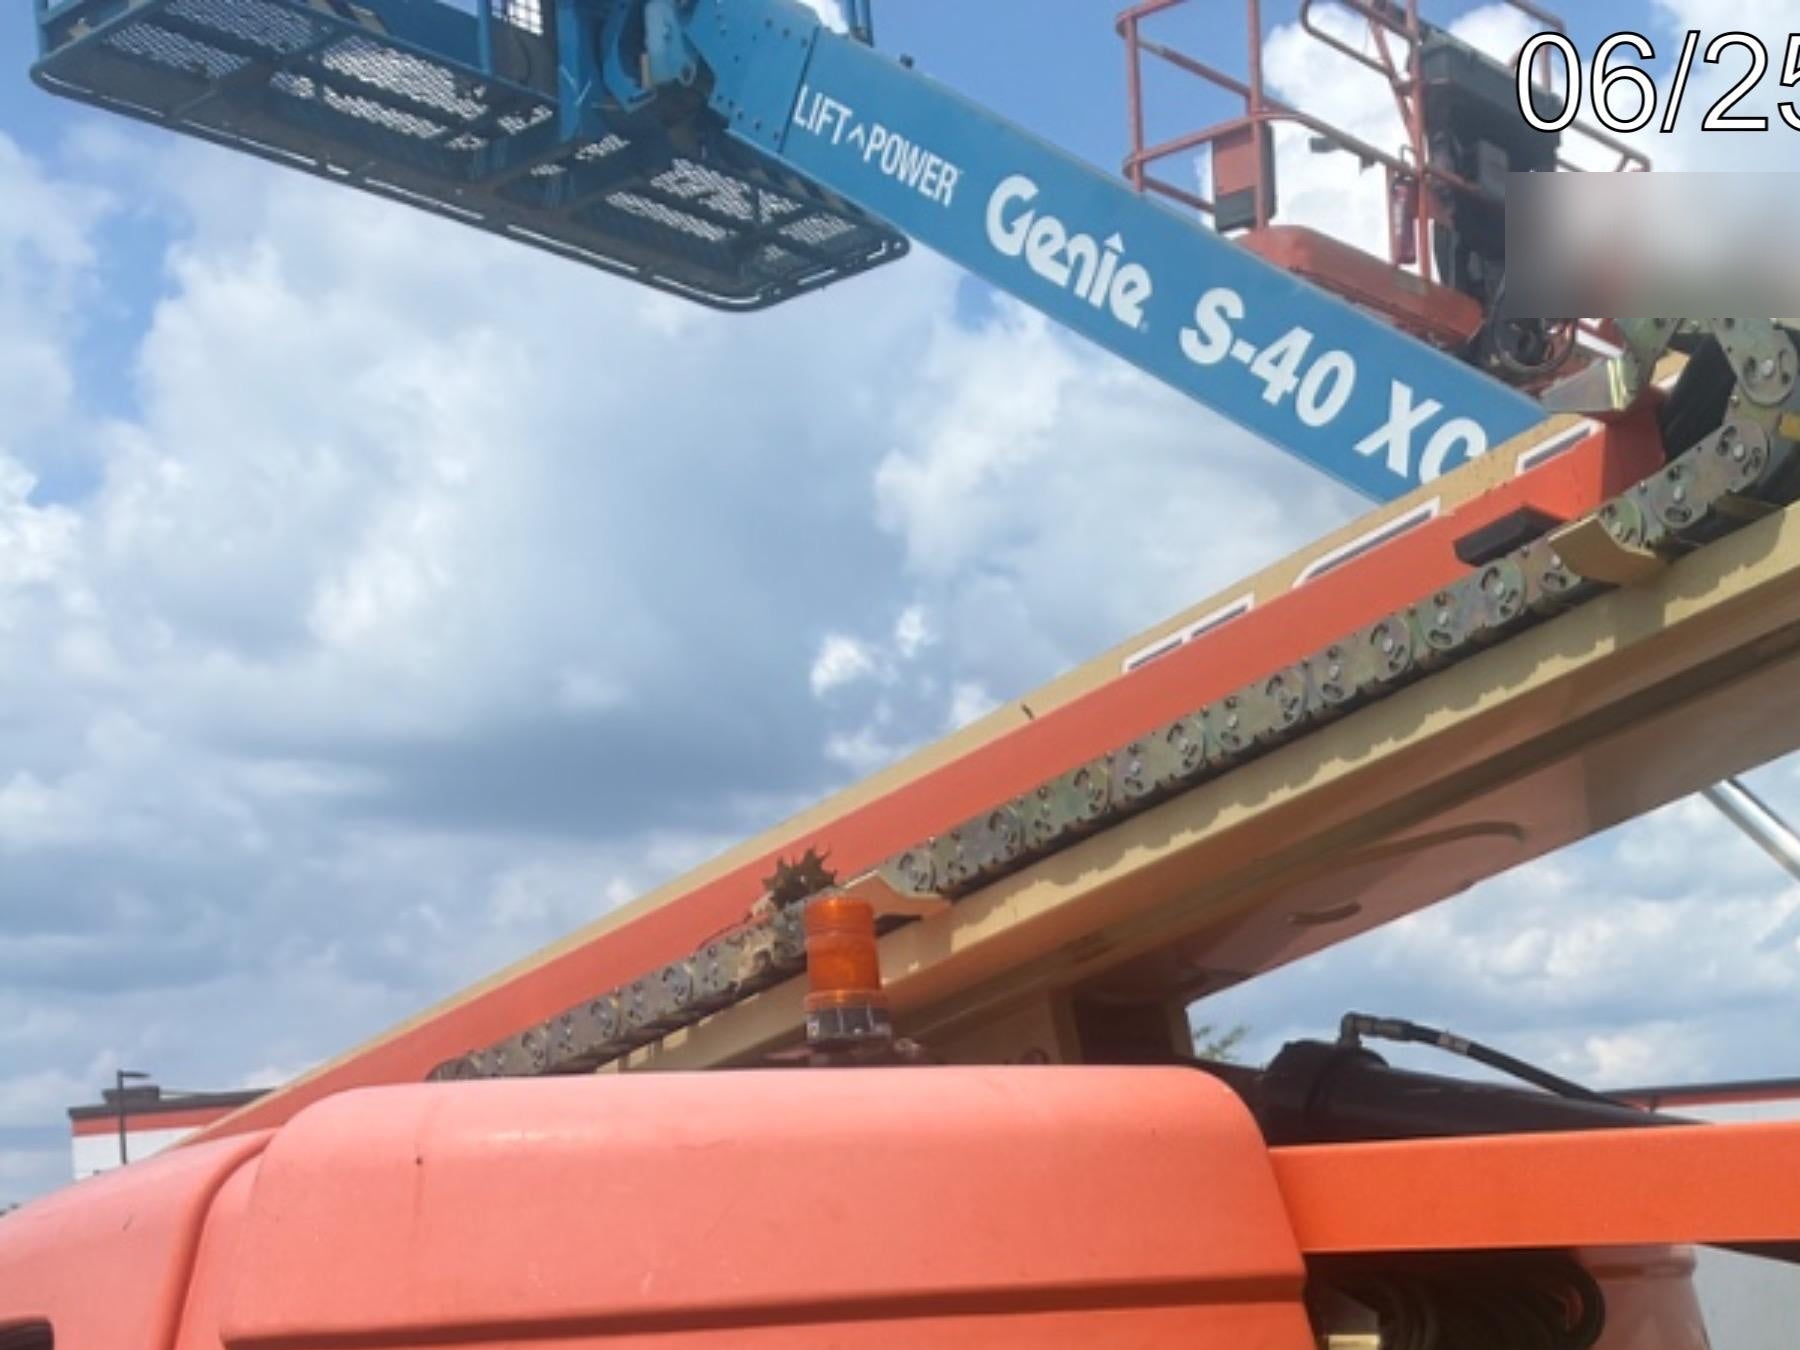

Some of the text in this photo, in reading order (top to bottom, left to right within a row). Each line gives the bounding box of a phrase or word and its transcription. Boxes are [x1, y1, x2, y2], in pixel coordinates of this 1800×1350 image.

[863, 123, 959, 207] POWER
[986, 174, 1153, 329] Genie
[1179, 286, 1357, 428] S-40
